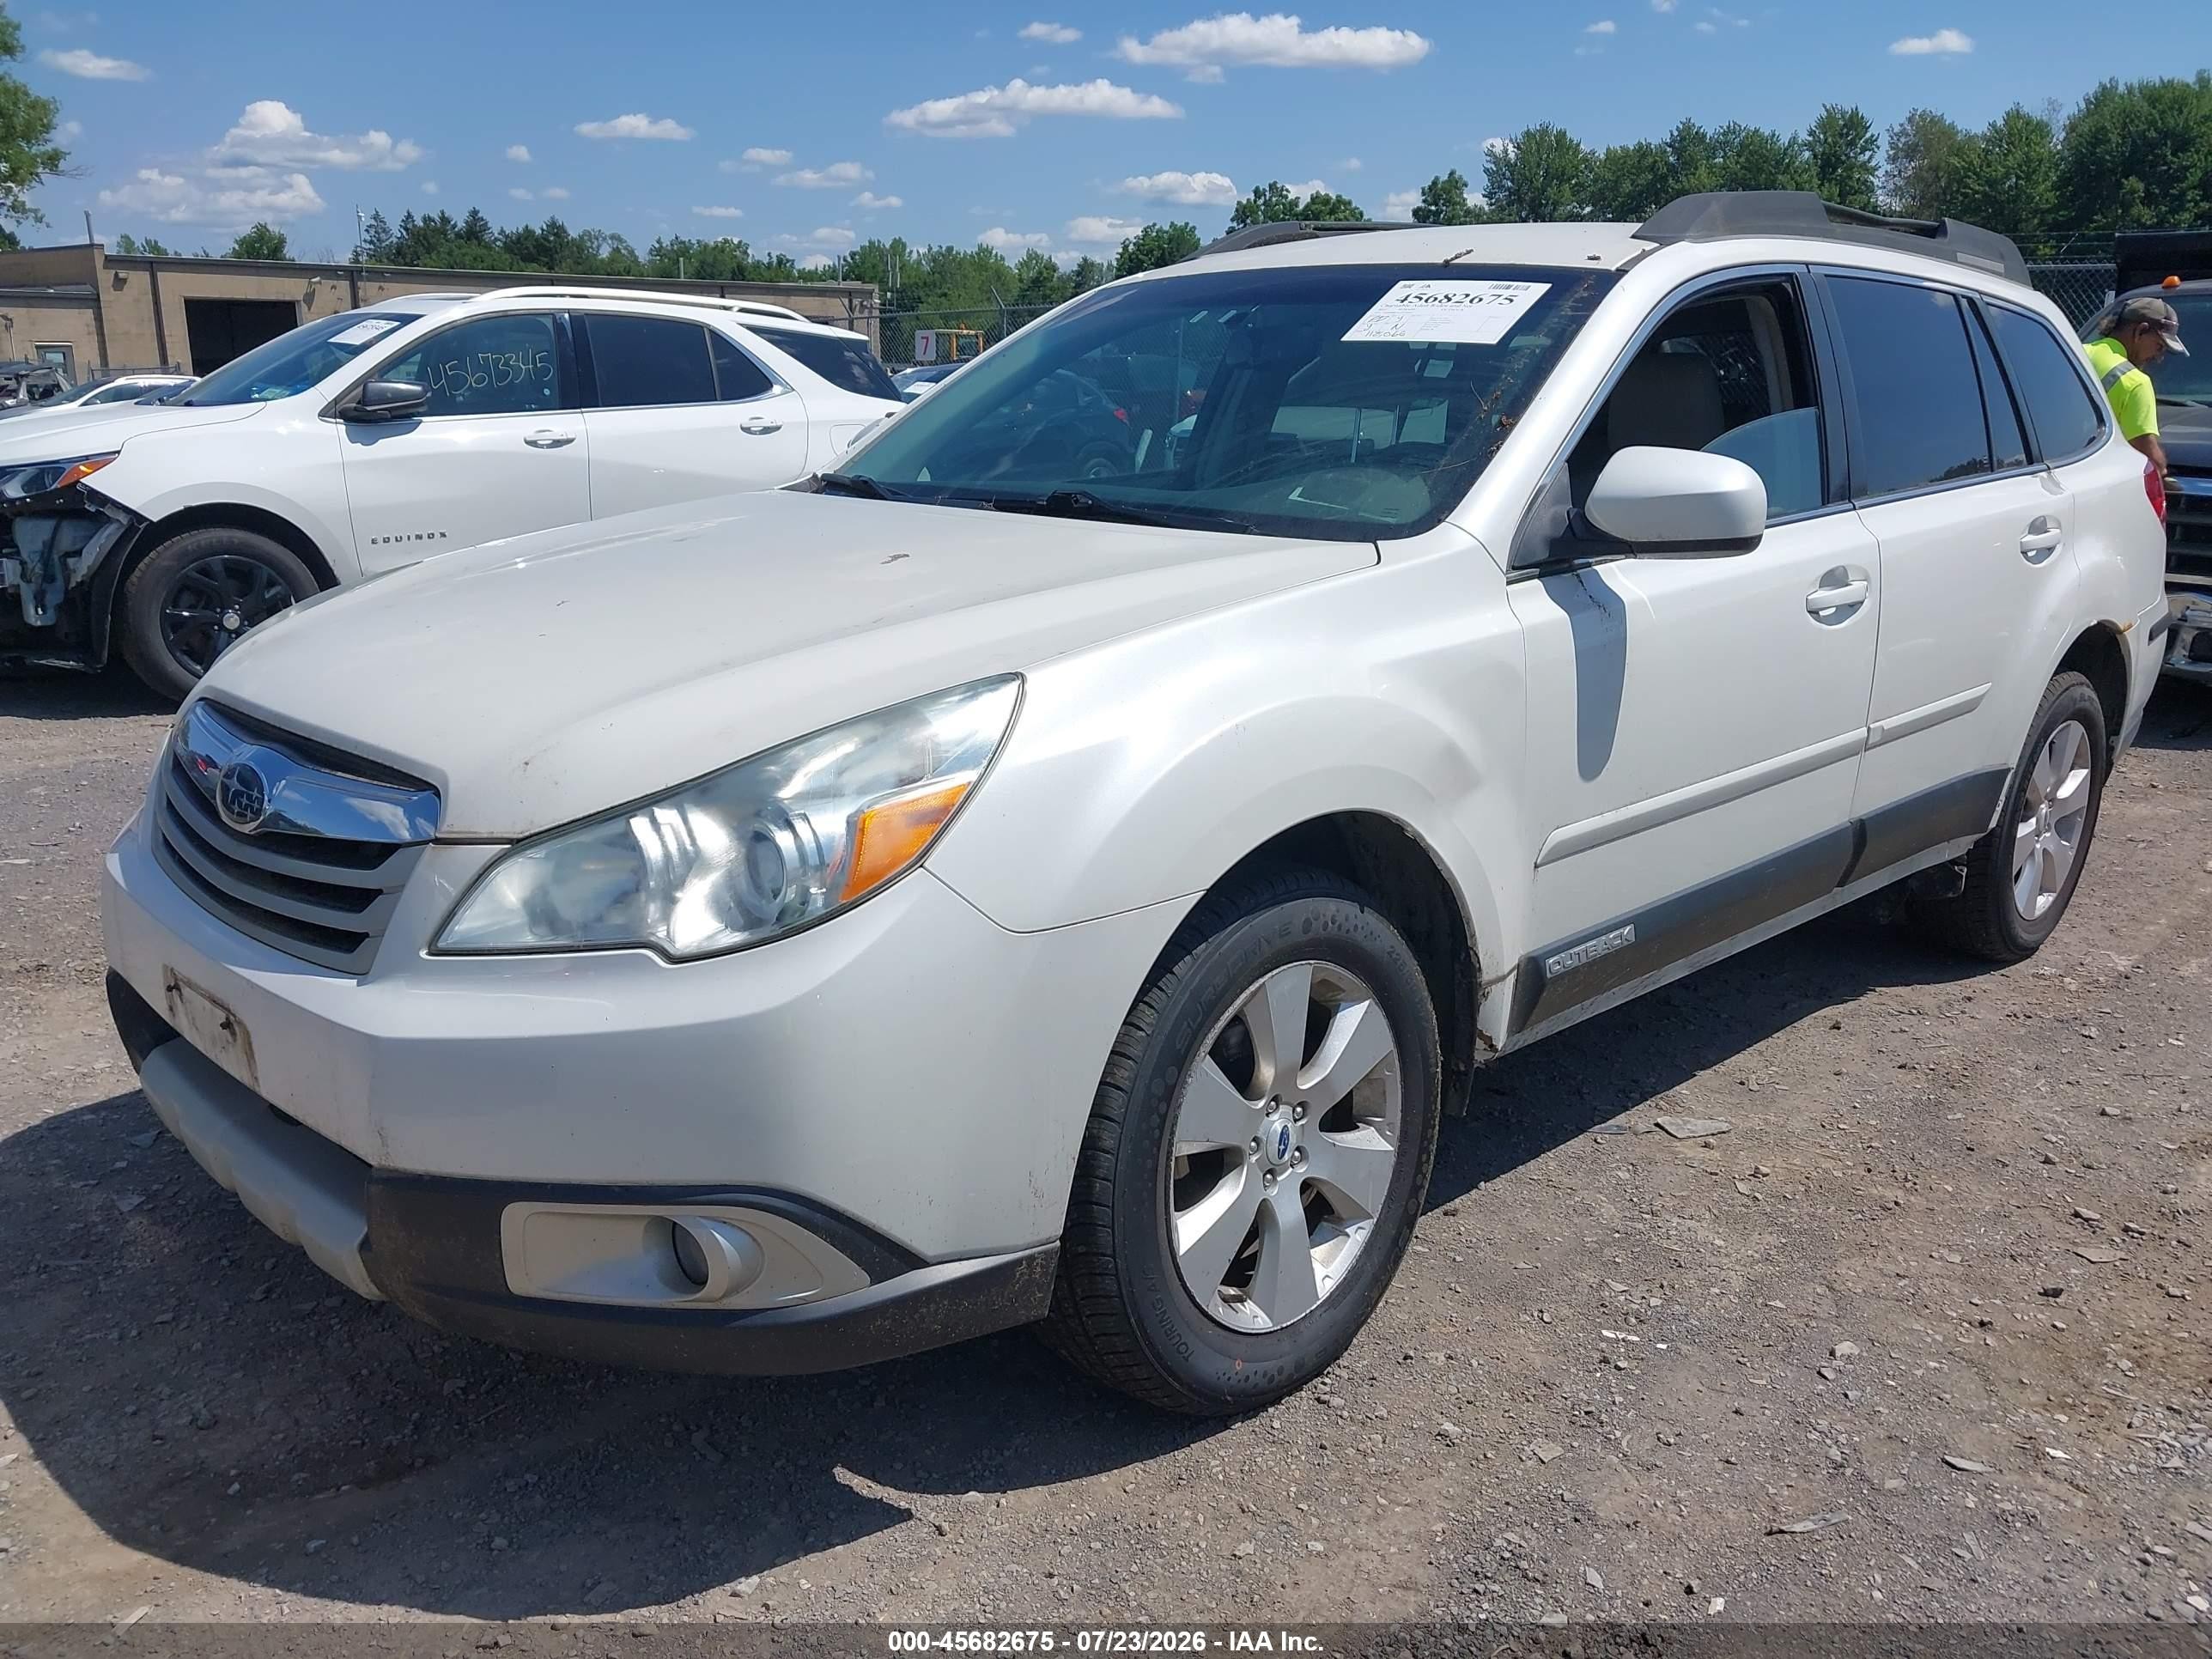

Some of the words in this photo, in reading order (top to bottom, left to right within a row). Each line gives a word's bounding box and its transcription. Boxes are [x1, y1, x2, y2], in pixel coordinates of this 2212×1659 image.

[1395, 292, 1519, 306] 45682675
[920, 336, 930, 356] 7
[427, 348, 554, 397] 45673345
[370, 531, 447, 545] EQUINOX
[1548, 925, 1633, 975] OUTBACK
[1152, 1294, 1195, 1363] TOURING
